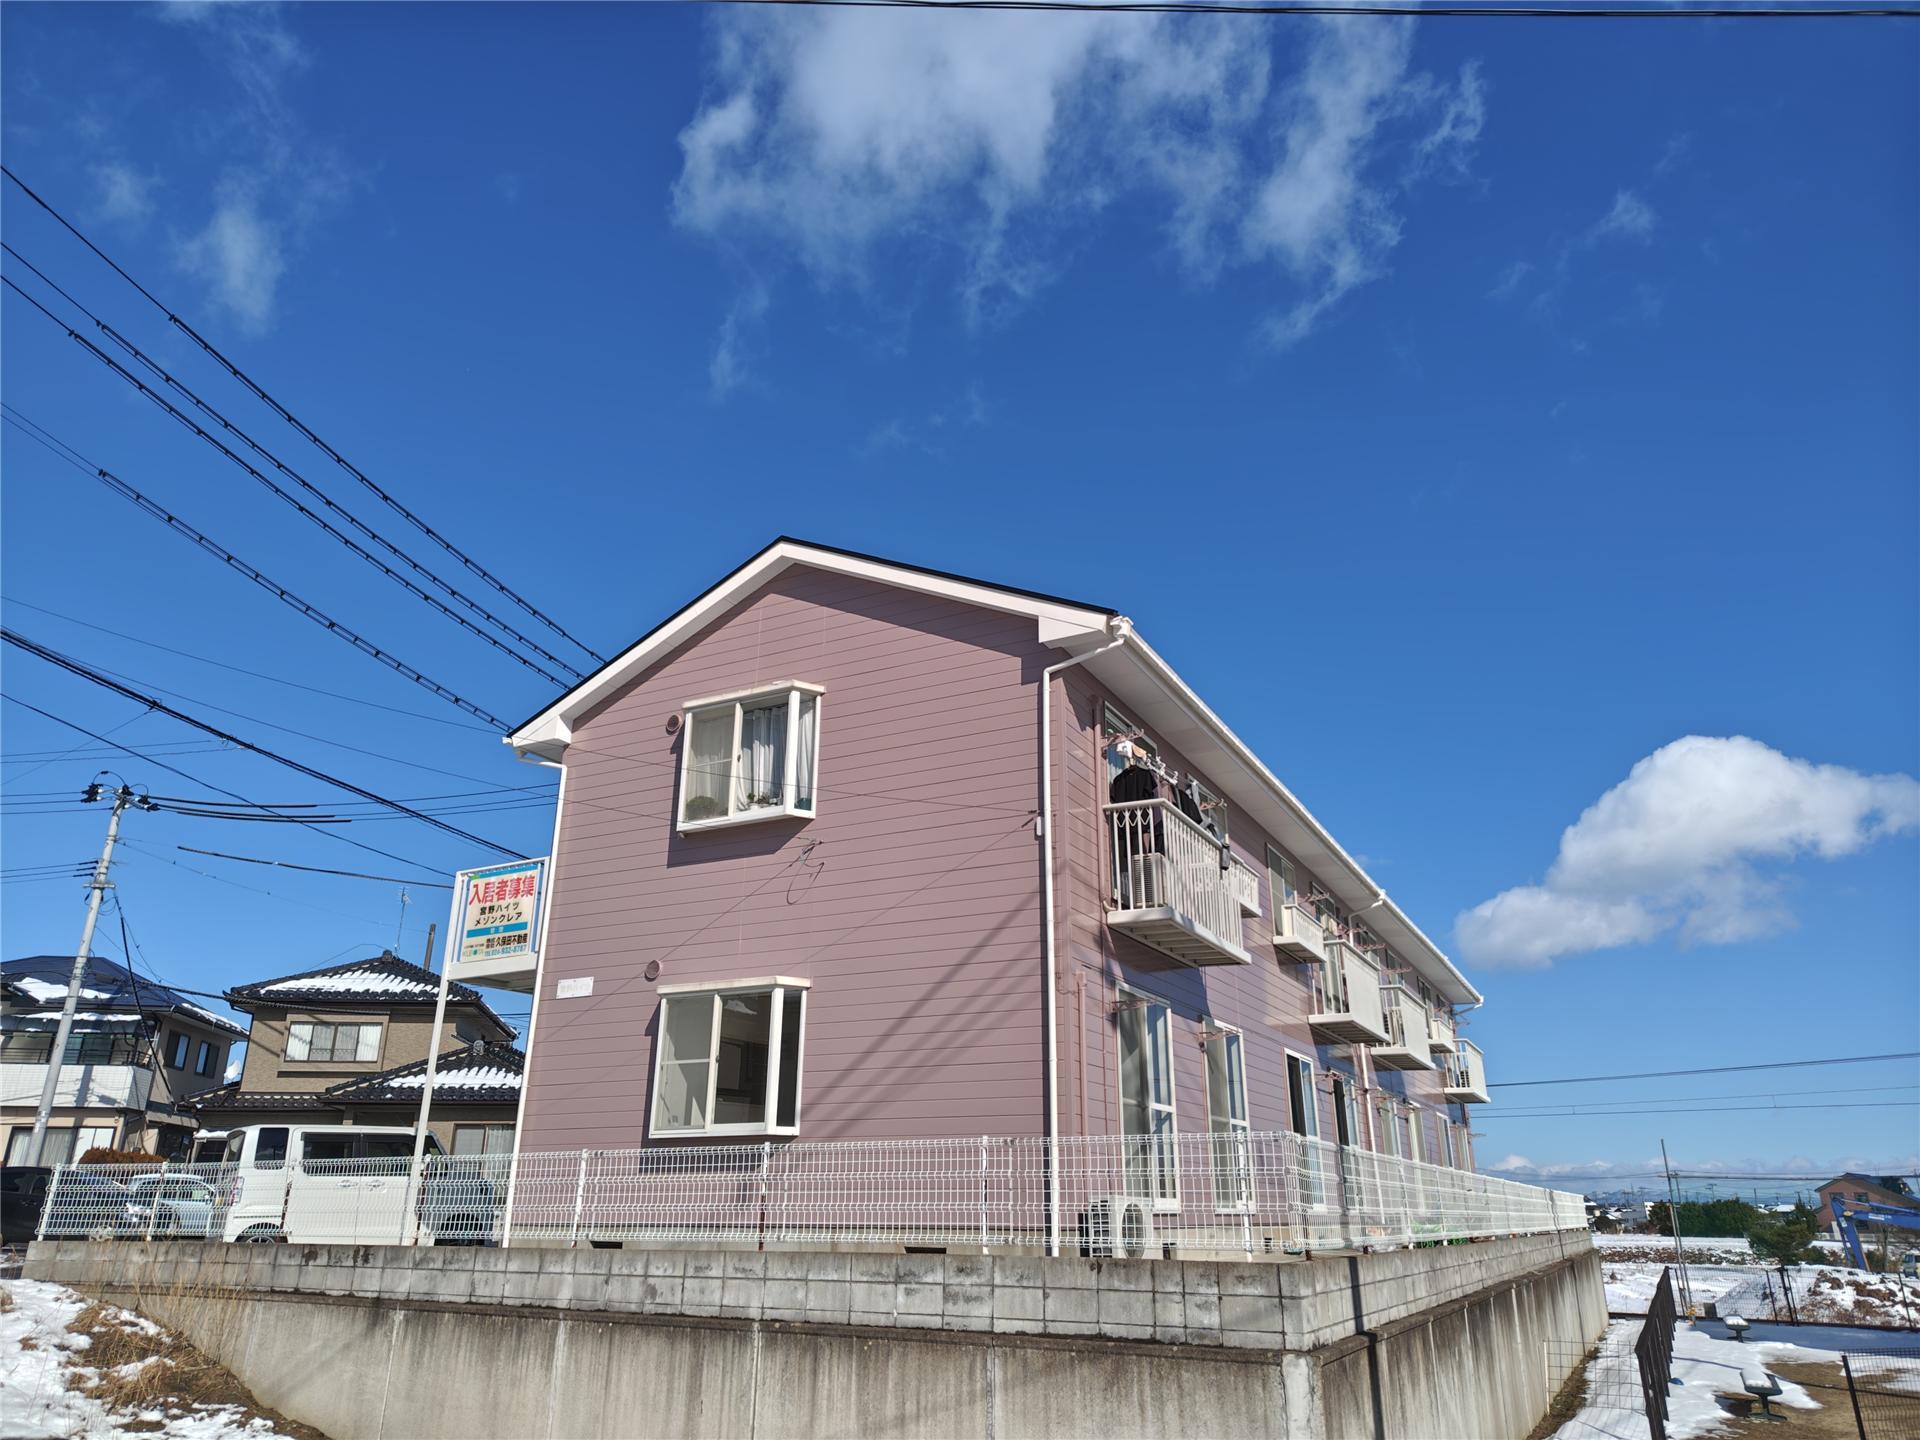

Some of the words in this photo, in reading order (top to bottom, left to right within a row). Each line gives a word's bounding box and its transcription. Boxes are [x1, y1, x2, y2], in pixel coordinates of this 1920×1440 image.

[469, 875, 535, 905] 入居者募集
[475, 912, 522, 926] メゾンクレア
